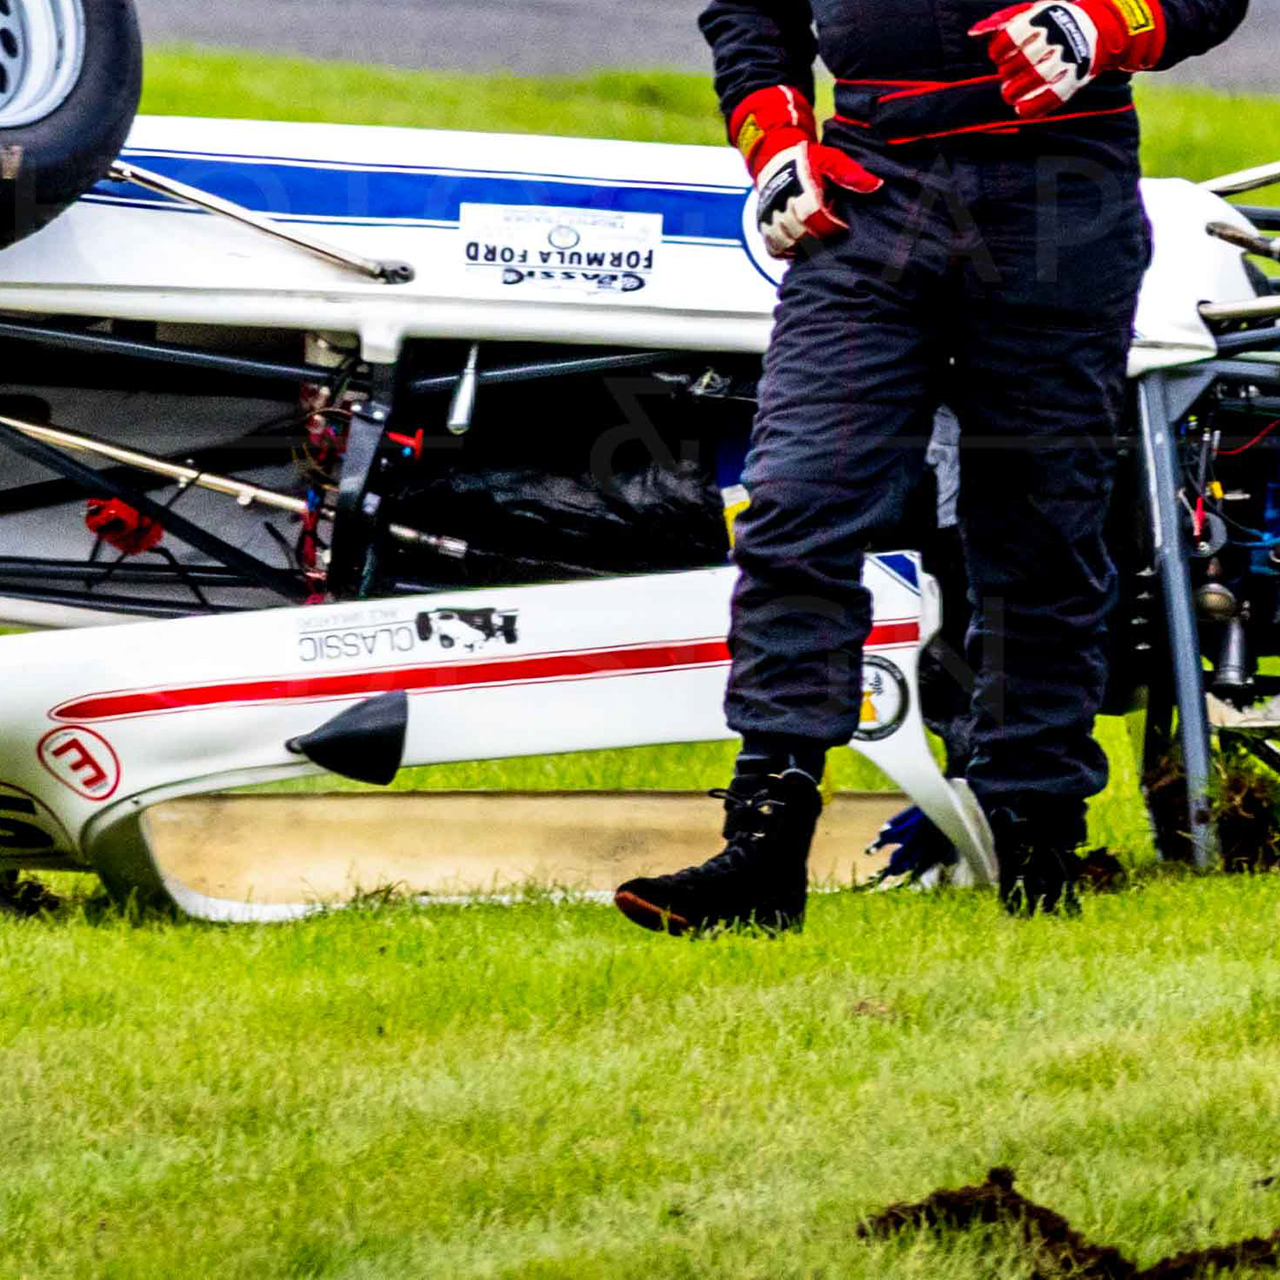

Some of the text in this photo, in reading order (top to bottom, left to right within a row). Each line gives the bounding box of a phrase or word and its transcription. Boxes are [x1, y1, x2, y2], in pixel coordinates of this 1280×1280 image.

[465, 241, 654, 269] FORMULA FORD
[299, 626, 417, 662] CLASSIC
[52, 737, 108, 790] E
